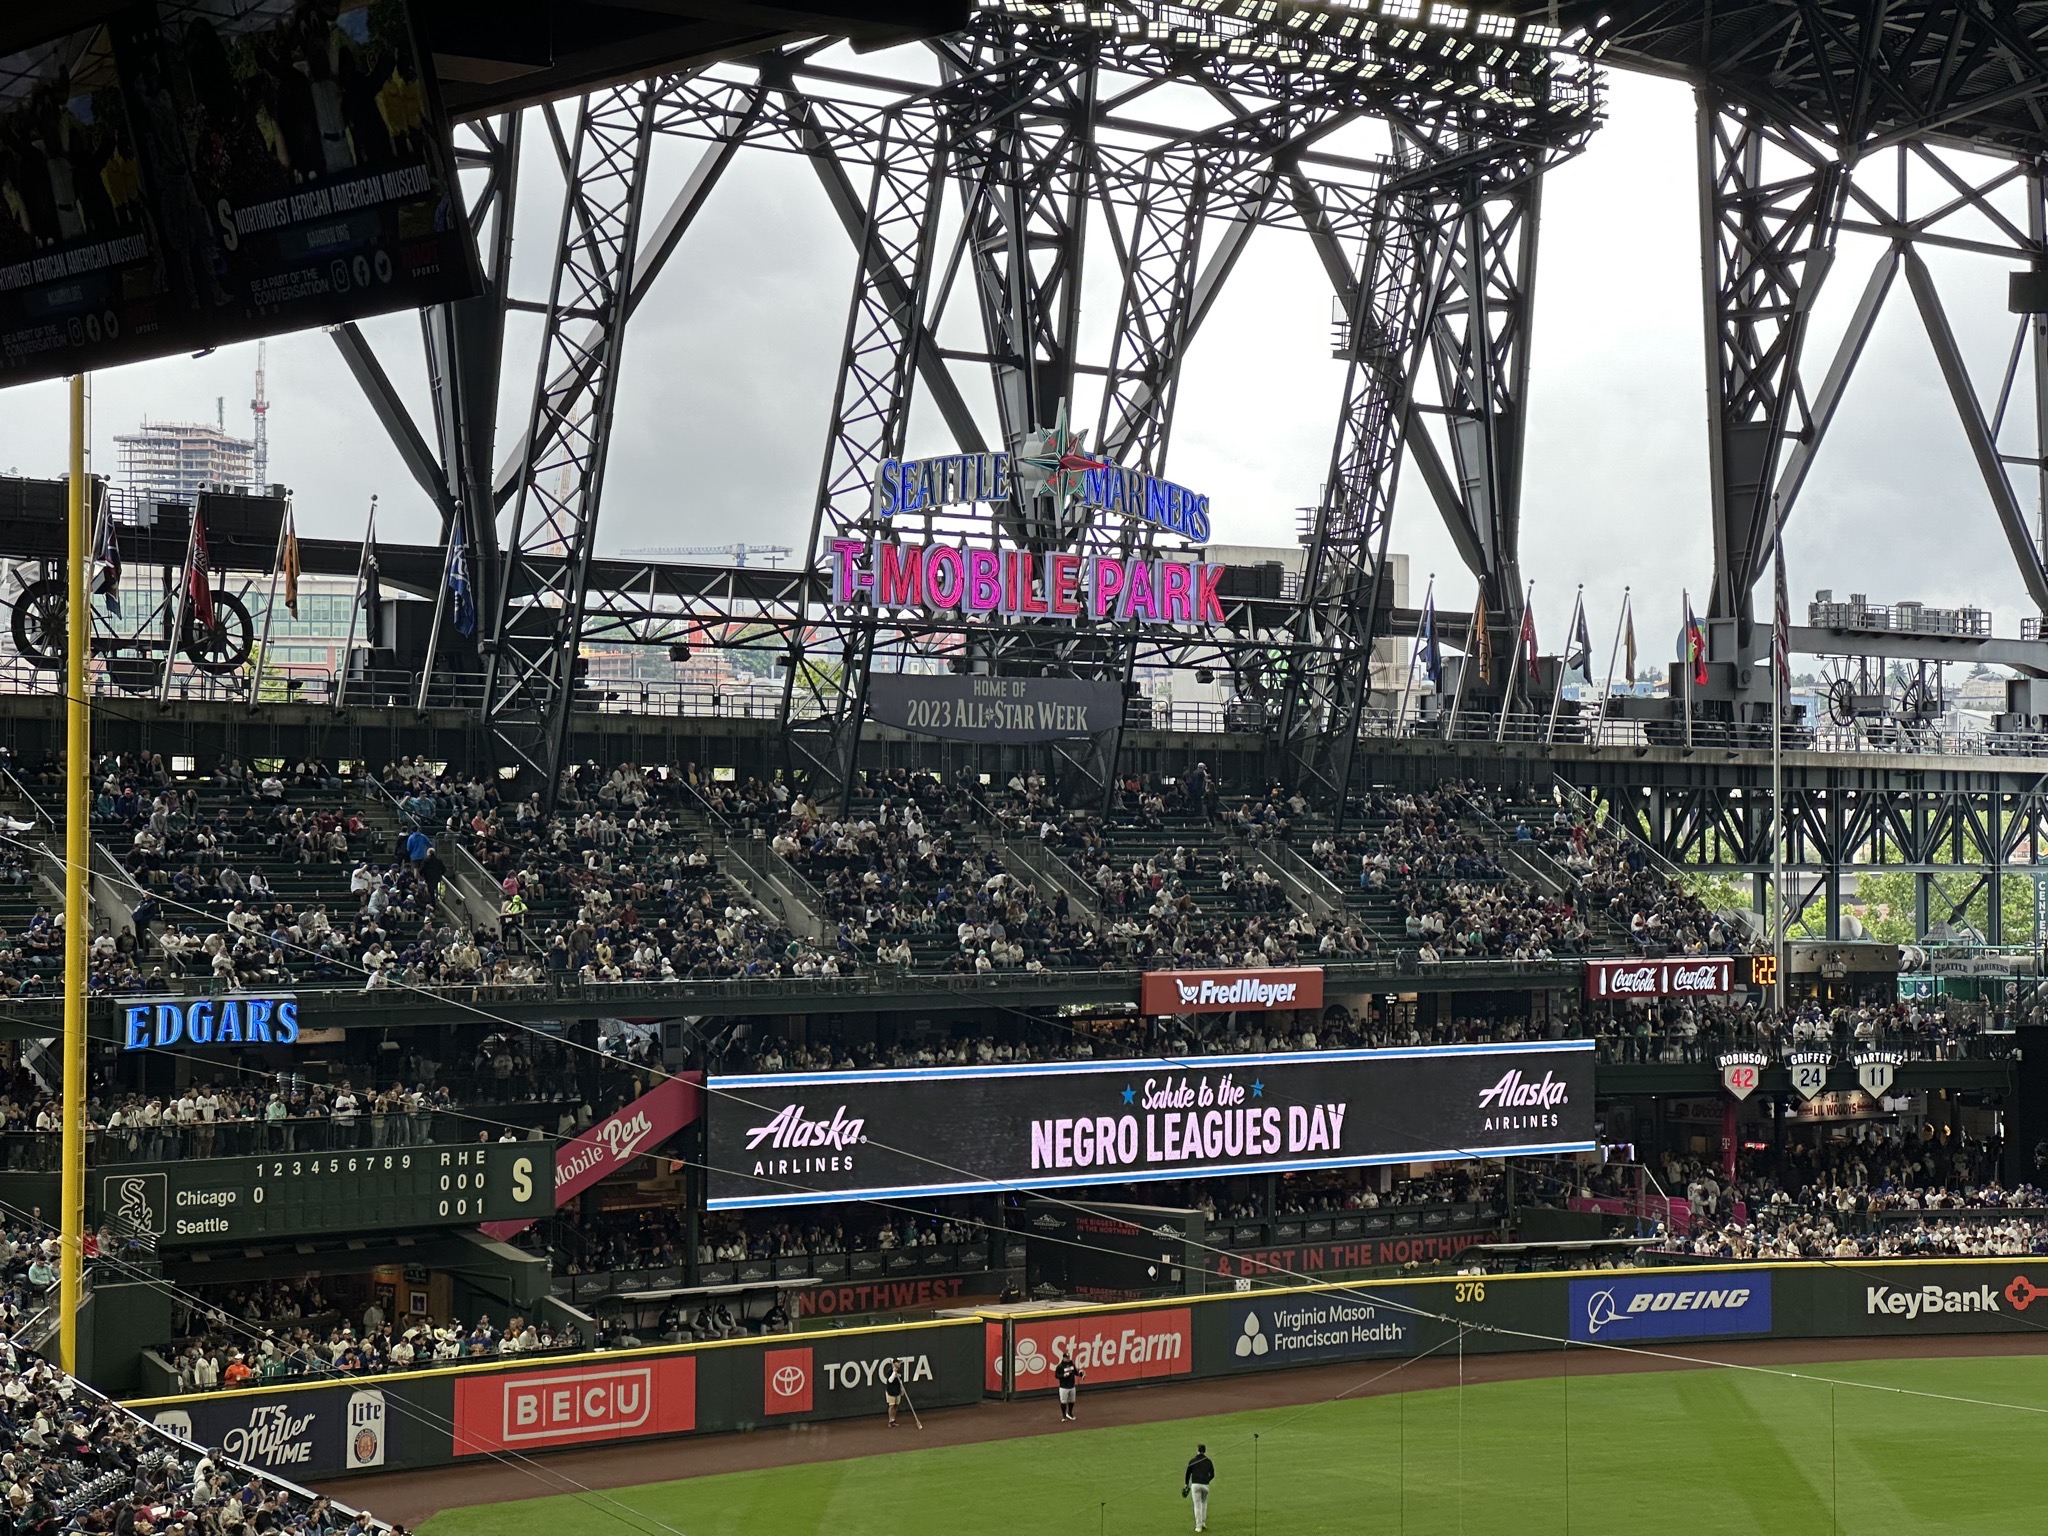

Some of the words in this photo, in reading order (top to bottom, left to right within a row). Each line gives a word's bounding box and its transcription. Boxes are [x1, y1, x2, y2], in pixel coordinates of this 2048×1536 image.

[235, 197, 291, 236] NORTHWEST
[290, 188, 332, 222] AFRICAN
[331, 176, 384, 214] AMERICAN
[381, 163, 432, 201] MUSEUM
[32, 253, 68, 284] AFRICAN
[66, 242, 110, 275] AMERICAN
[107, 233, 149, 265] MUSEUM
[411, 263, 441, 278] SPORTS
[251, 280, 263, 293] BE
[268, 273, 290, 289] PART
[290, 271, 303, 283] OF
[302, 267, 319, 282] THE
[253, 279, 330, 306] CONVERSATION
[5, 333, 68, 358] CONVERSATION
[877, 451, 1010, 518] SEATTLE
[1081, 451, 1211, 544] MARINERS
[1090, 555, 1226, 625] PARK
[973, 680, 1006, 697] HOME
[1012, 681, 1026, 697] OF
[907, 699, 951, 728] 2023
[1037, 701, 1088, 731] WEEK
[2038, 880, 2047, 941] CENTER
[1752, 955, 1777, 985] 1:22
[1934, 962, 1970, 976] SEATTLE
[1972, 961, 2011, 976] MARINERS
[124, 1000, 298, 1050] EDGAR'S
[1719, 1053, 1769, 1067] ROBINSON
[1790, 1052, 1832, 1066] GRIFFEY
[1853, 1053, 1904, 1067] MARTINEZ
[1142, 1076, 1195, 1110] Salute
[1199, 1076, 1214, 1108] to
[1217, 1072, 1245, 1105] the
[1478, 1068, 1567, 1110] Alaska
[1730, 1068, 1754, 1089] 42
[1800, 1068, 1822, 1088] 24
[1869, 1067, 1885, 1087] 11
[1484, 1113, 1559, 1131] AIRLINES
[1813, 1104, 1825, 1116] LIL
[745, 1103, 865, 1151] Alaska
[1031, 1114, 1139, 1170] NEGRO
[1146, 1106, 1282, 1163] LEAGUES
[1289, 1102, 1347, 1152] DAY
[257, 1164, 263, 1177] 1
[274, 1163, 283, 1177] 2
[293, 1162, 301, 1175] 3
[311, 1161, 320, 1174] 4
[330, 1159, 338, 1173] 5
[348, 1158, 357, 1171] 6
[366, 1157, 375, 1170] 7
[384, 1156, 392, 1169] 8
[402, 1155, 411, 1168] 9
[441, 1152, 450, 1166] R
[459, 1152, 468, 1165] H
[476, 1151, 485, 1164] E
[753, 1155, 853, 1176] AIRLINES
[176, 1190, 236, 1207] Chicago
[253, 1187, 264, 1203] 0
[440, 1175, 449, 1190] 0
[457, 1174, 467, 1189] 0
[475, 1173, 484, 1188] 0
[512, 1157, 533, 1203] S
[176, 1217, 229, 1235] Seattle
[439, 1200, 448, 1216] 0
[457, 1199, 466, 1215] 0
[477, 1198, 483, 1214] 1
[1217, 1256, 1233, 1278] &
[1240, 1249, 1296, 1277] BEST
[1303, 1247, 1325, 1270] IN
[1330, 1243, 1374, 1268] THE
[799, 1278, 964, 1317] NORTHWEST
[1454, 1282, 1485, 1303] 376
[1626, 1288, 1750, 1314] BOEING
[1867, 1285, 1999, 1320] KeyBank
[1274, 1307, 1327, 1333] Virginia
[1329, 1304, 1375, 1323] Mason
[1274, 1330, 1348, 1352] Franciscan
[824, 1355, 933, 1391] TOYOTA
[248, 1404, 288, 1428] IT'S
[351, 1402, 381, 1427] Lite
[223, 1413, 316, 1464] Miller
[265, 1441, 313, 1466] TIME
